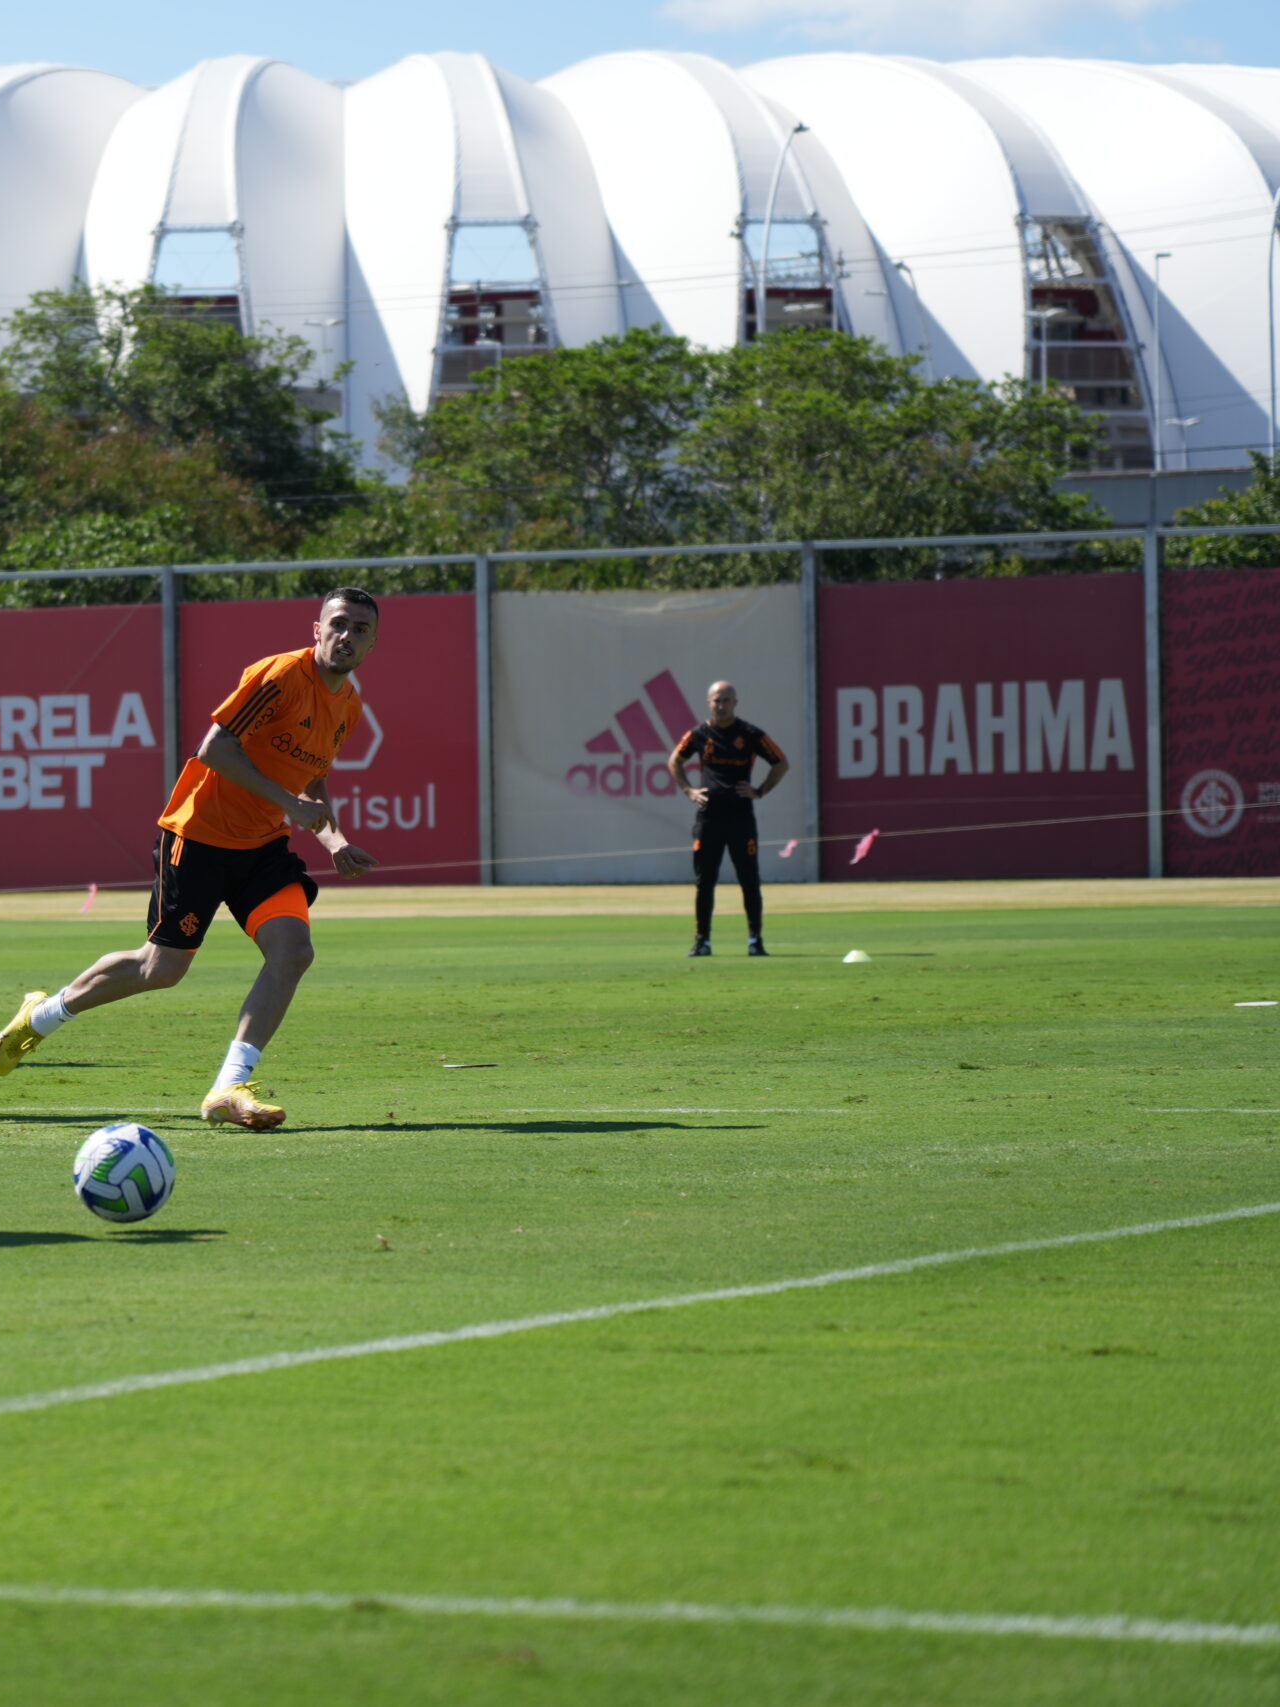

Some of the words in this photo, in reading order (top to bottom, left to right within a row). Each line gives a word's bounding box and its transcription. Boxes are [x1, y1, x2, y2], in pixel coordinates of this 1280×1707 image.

[836, 678, 1134, 779] BRAHMA
[290, 743, 329, 770] banris
[331, 782, 436, 831] risul
